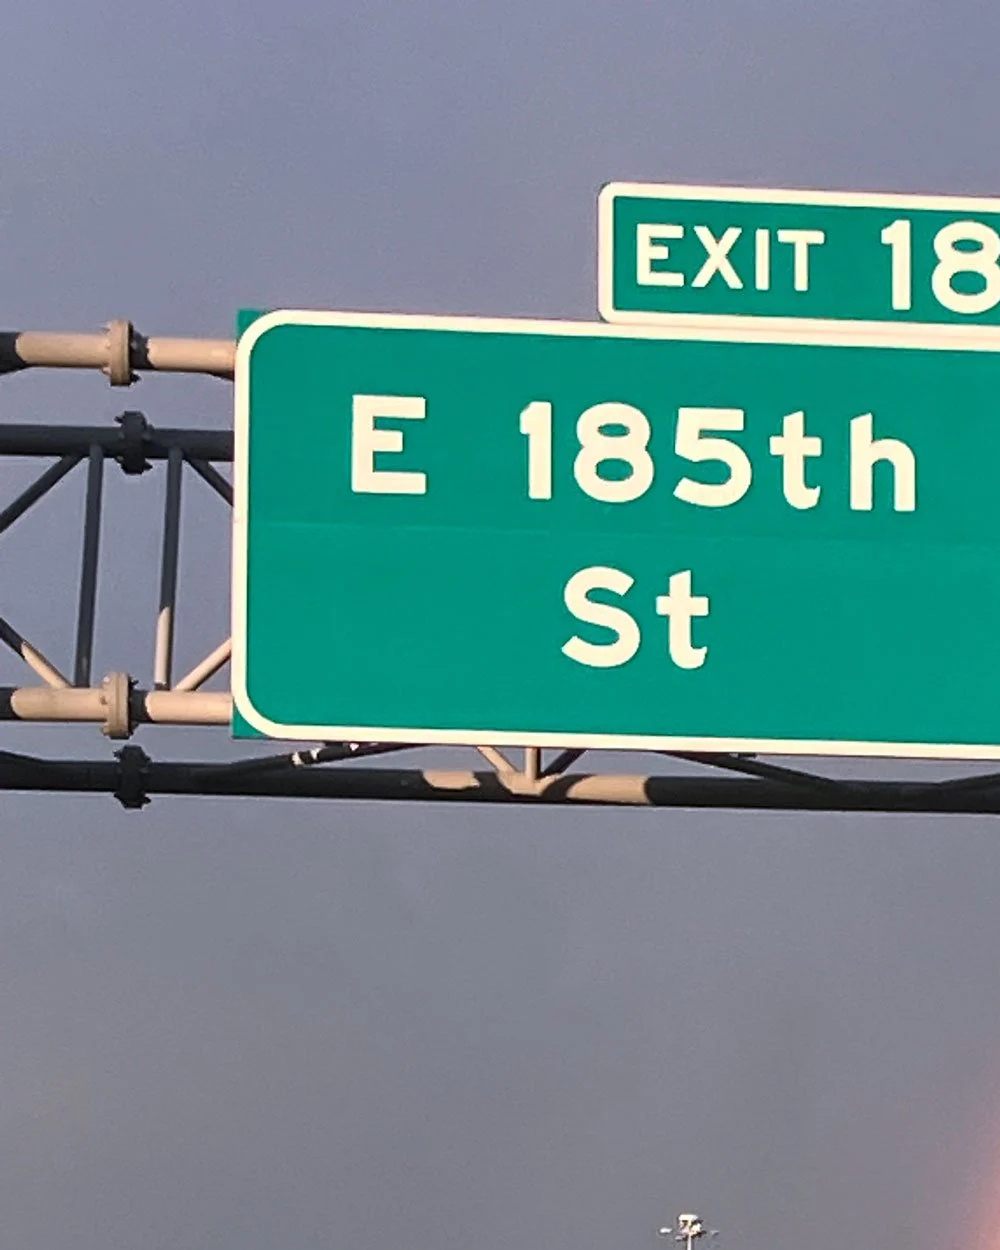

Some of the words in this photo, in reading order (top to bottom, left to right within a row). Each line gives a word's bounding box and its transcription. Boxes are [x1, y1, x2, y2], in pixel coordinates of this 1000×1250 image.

[636, 223, 825, 291] EXIT
[351, 394, 426, 494] E
[520, 401, 916, 512] 185th
[561, 566, 709, 669] St
